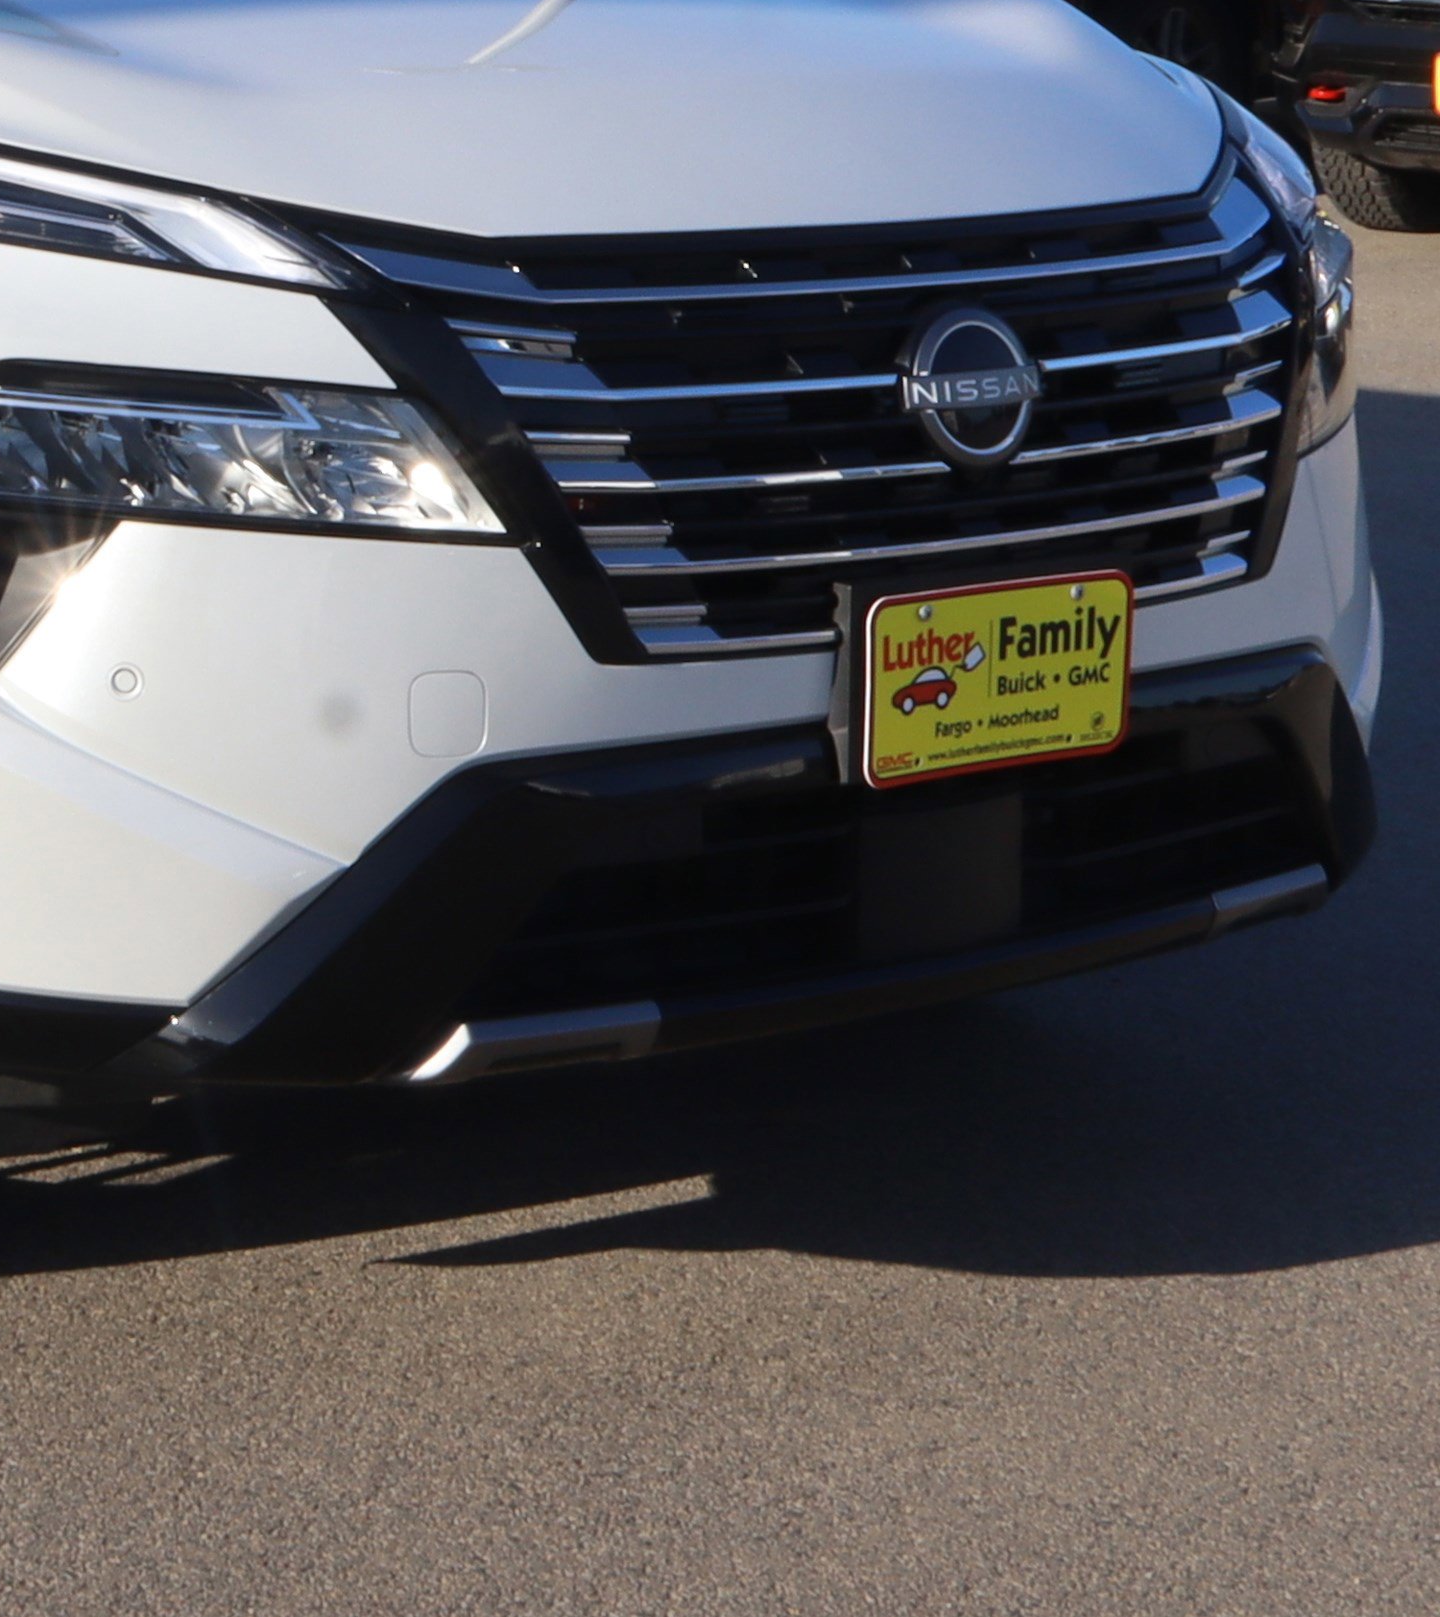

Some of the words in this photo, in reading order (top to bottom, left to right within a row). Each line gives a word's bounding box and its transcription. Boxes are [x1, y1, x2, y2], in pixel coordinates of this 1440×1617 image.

[910, 373, 1040, 405] NISSAN
[882, 628, 977, 672] Luther
[998, 606, 1121, 661] Family
[996, 670, 1046, 696] Buick
[1068, 663, 1111, 686] GMC
[934, 720, 972, 738] Fargo
[988, 704, 1060, 729] Moorhead
